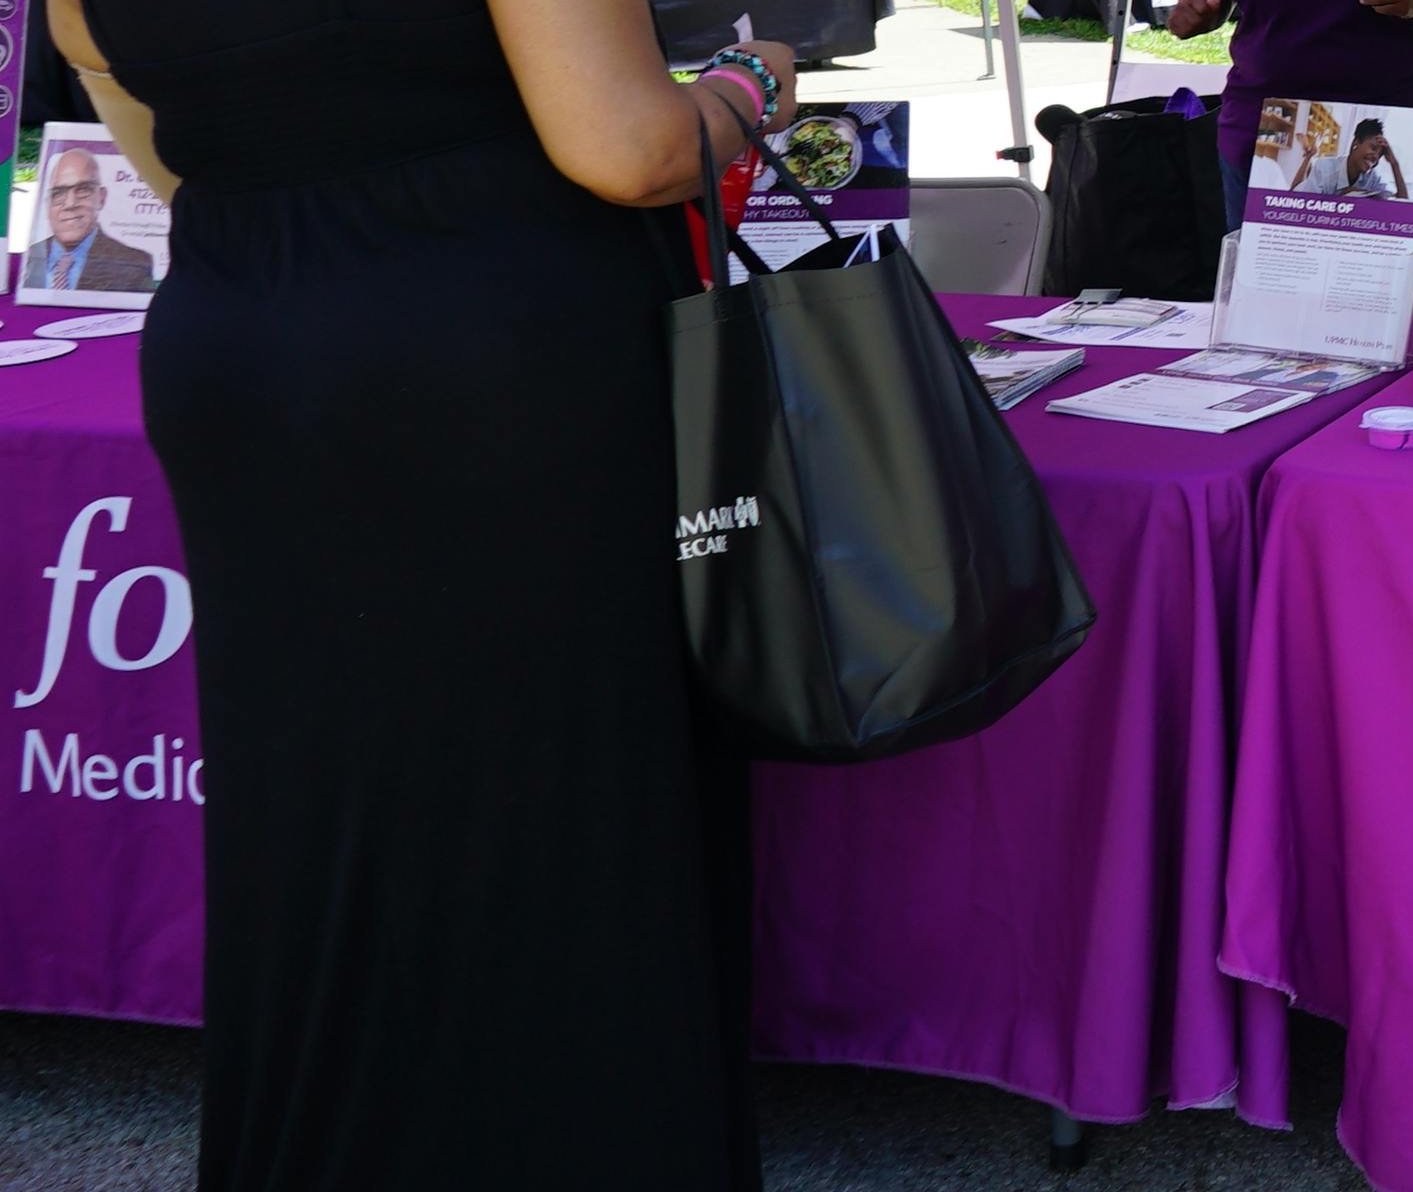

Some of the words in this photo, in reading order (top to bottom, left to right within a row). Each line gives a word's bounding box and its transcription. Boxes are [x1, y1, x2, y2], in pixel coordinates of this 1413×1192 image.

[1264, 195, 1305, 209] TAKING
[1306, 199, 1337, 212] CARE
[1337, 203, 1355, 214] OF
[1263, 210, 1306, 224] YOURSELF
[1307, 214, 1340, 227] DURING
[1341, 218, 1390, 232] STRESSFUL
